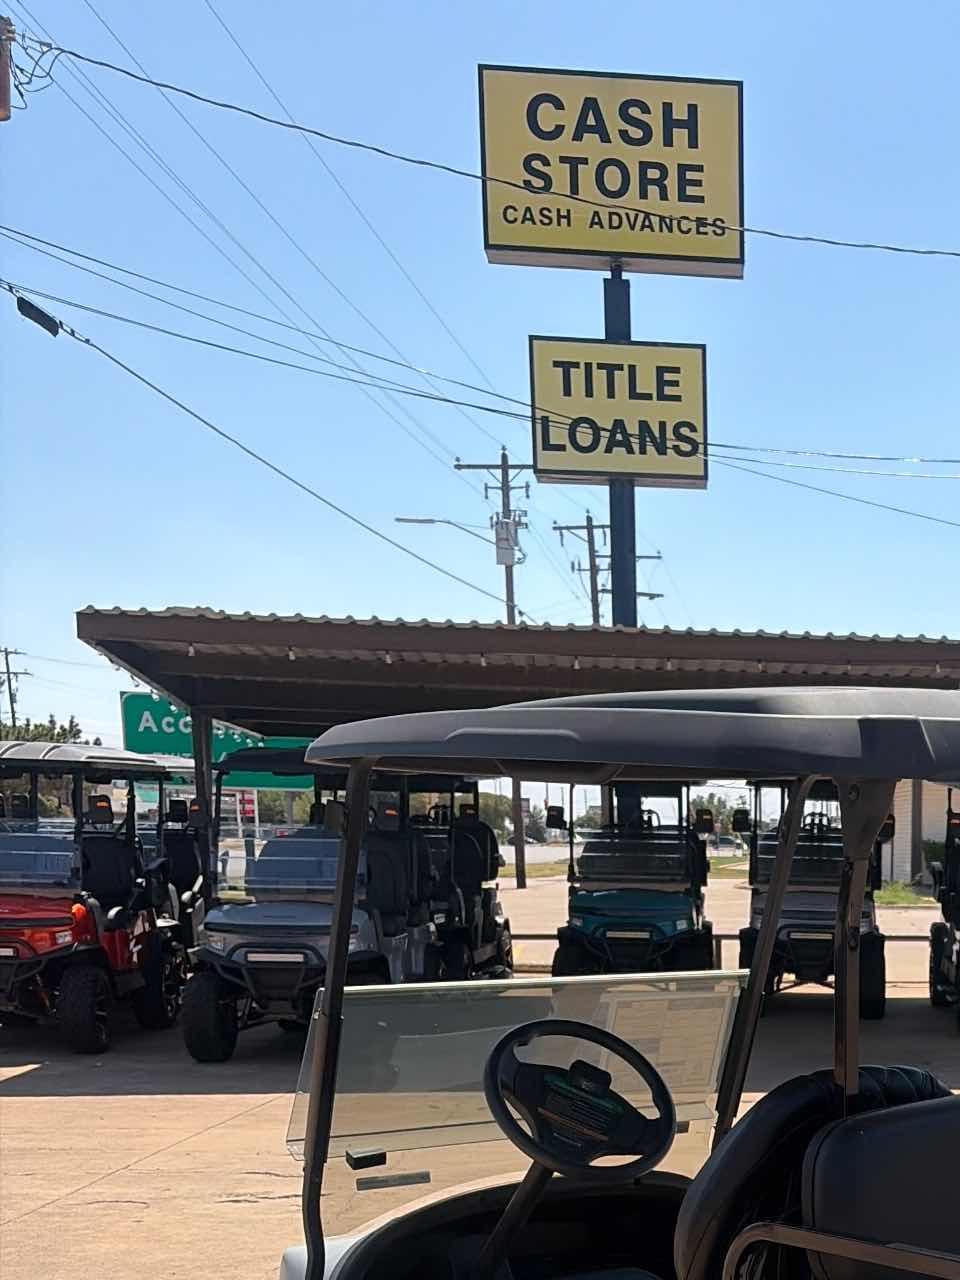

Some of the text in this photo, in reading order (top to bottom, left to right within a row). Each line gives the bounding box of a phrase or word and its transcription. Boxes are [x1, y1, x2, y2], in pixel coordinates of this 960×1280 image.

[525, 93, 699, 149] CASH
[522, 153, 705, 204] STORE
[502, 205, 727, 237] CASH ADVANCES
[552, 360, 682, 402] TITLE
[540, 415, 699, 457] LOANS
